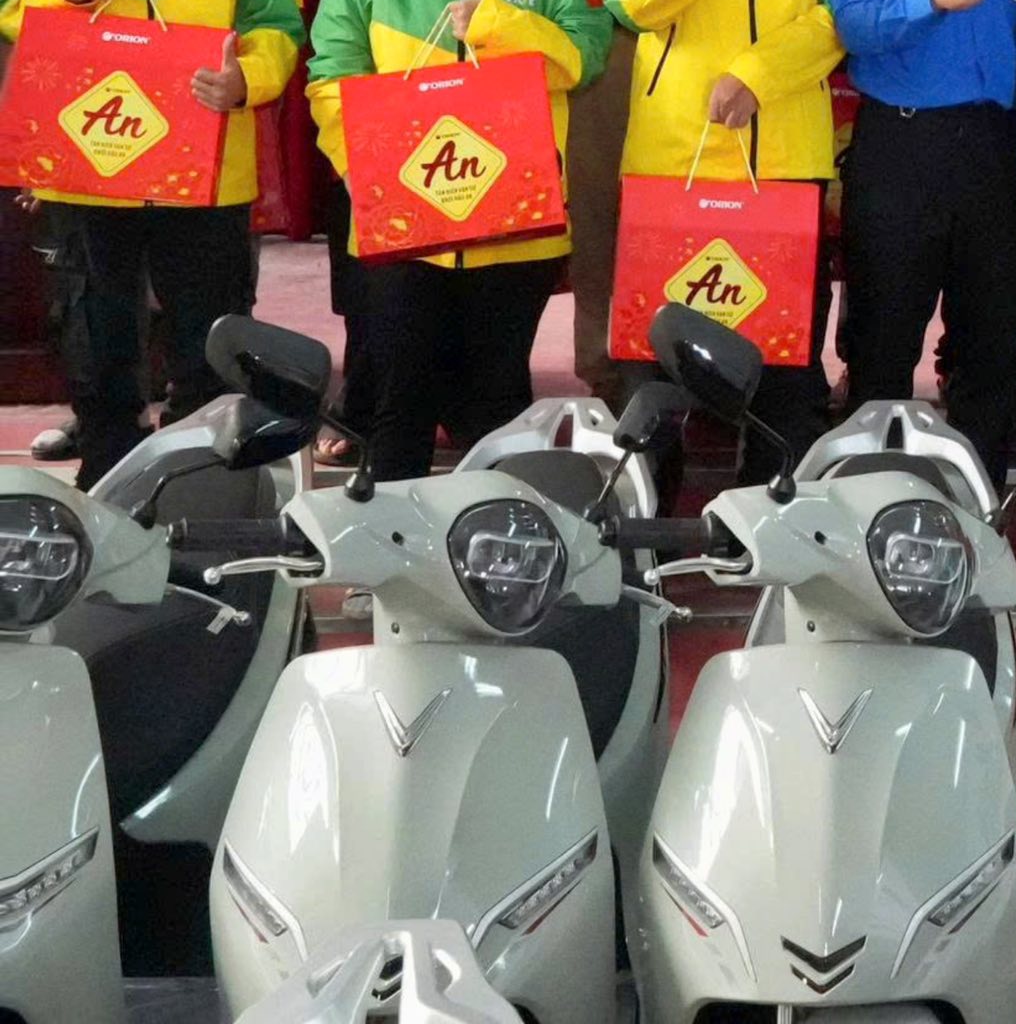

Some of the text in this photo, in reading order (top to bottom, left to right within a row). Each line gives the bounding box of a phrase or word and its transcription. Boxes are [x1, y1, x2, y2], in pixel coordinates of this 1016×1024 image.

[81, 95, 148, 139] An
[420, 140, 487, 189] An
[685, 263, 747, 306] An
